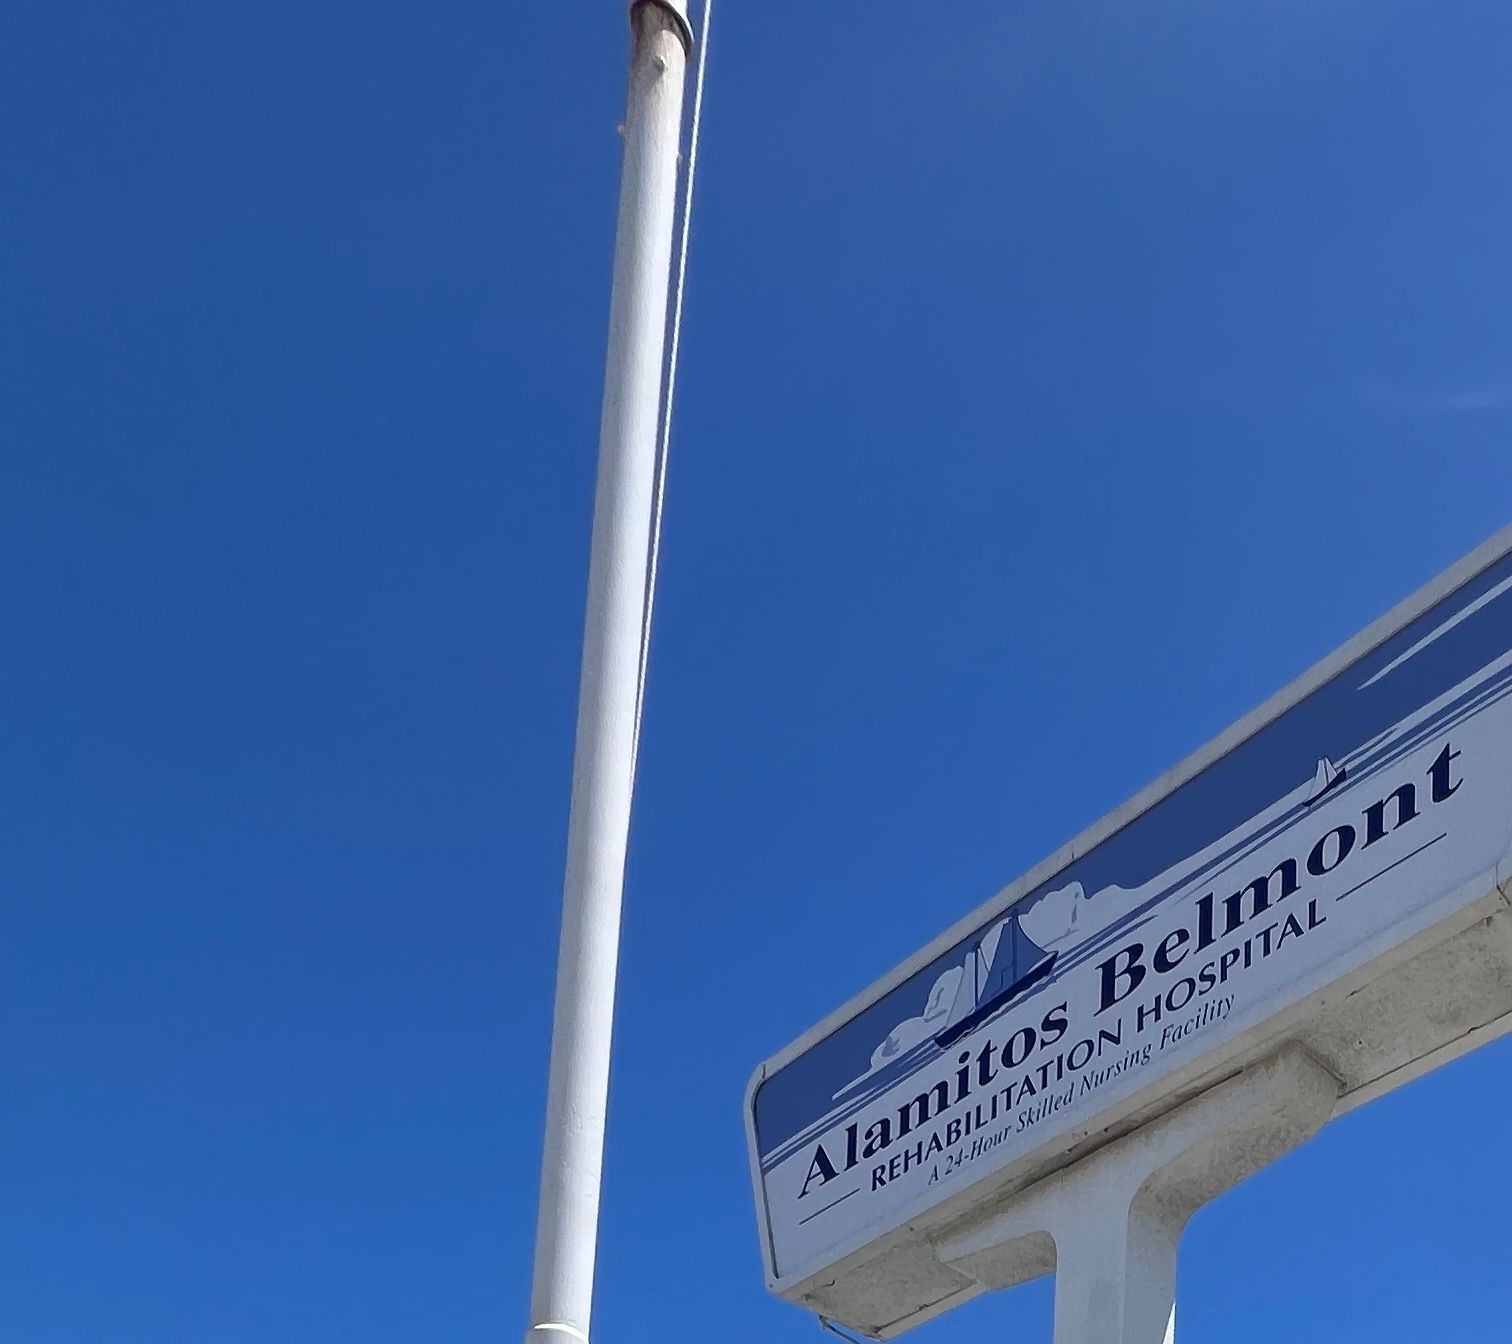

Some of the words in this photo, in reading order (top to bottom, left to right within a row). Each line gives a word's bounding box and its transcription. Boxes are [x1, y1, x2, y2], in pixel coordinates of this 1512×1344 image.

[797, 1000, 1069, 1200] Alamitos
[1093, 742, 1464, 1017] Belmont
[871, 1018, 1122, 1192] REHABILITATION
[1136, 898, 1327, 1033] HOSPITAL
[927, 1164, 939, 1186] A
[944, 1125, 1012, 1176] 24-Hour
[1016, 1081, 1075, 1134] Skilled
[1079, 1043, 1152, 1097] Nursing
[1159, 994, 1235, 1050] Facility
